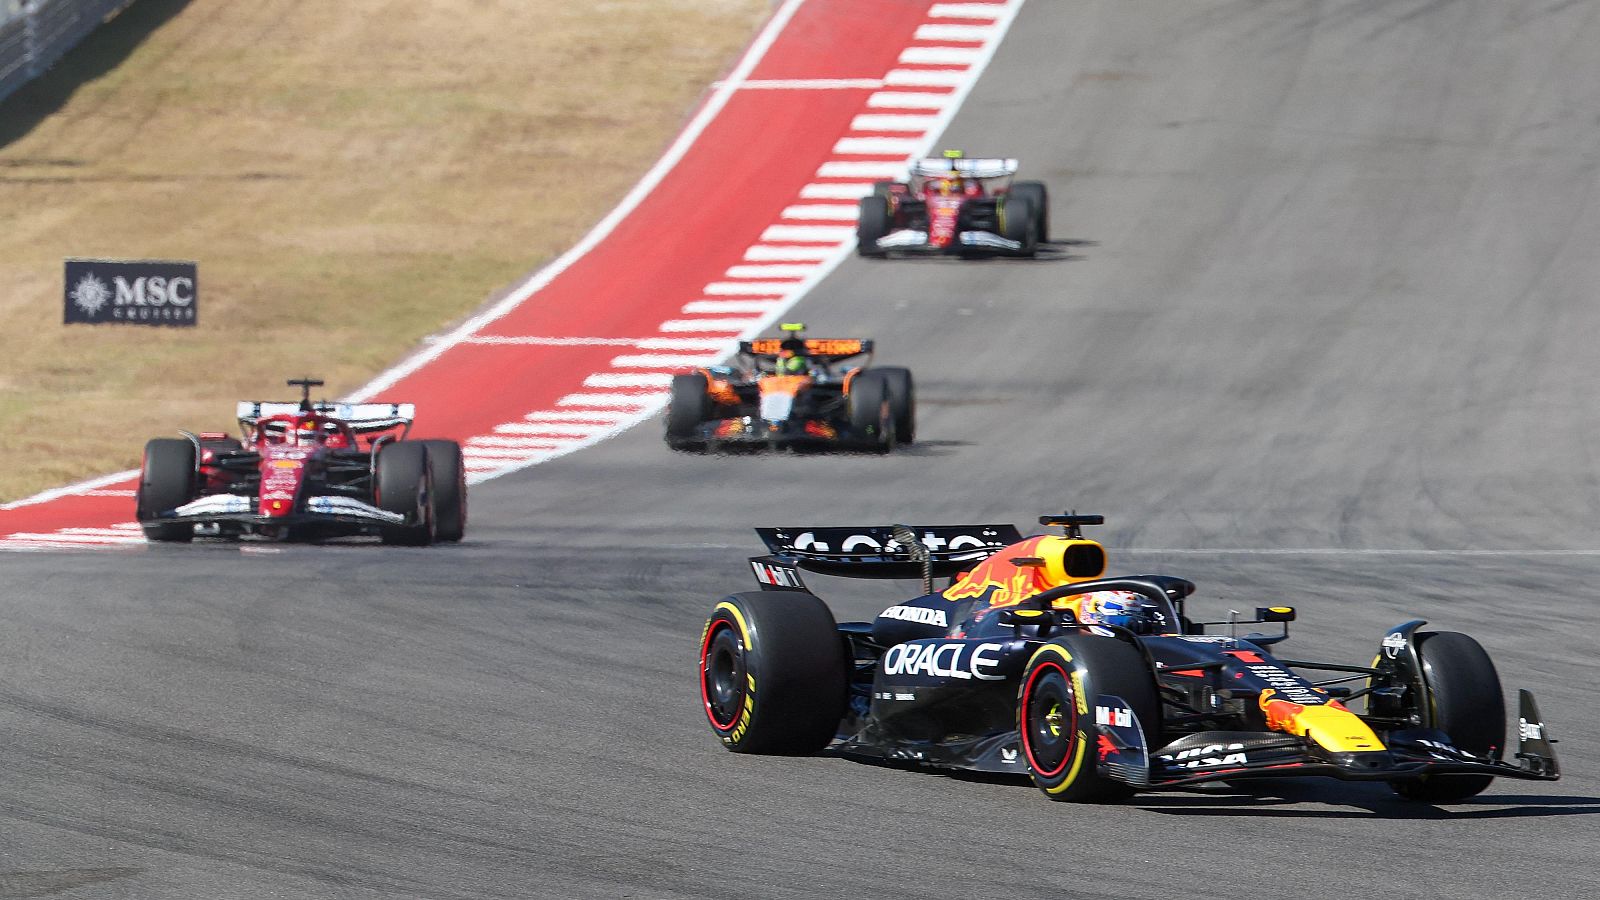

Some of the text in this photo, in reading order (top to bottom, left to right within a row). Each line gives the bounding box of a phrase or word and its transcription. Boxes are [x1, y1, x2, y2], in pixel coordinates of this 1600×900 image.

[113, 276, 193, 306] MSC
[879, 605, 948, 627] HONDA
[884, 643, 1007, 681] ORACLE
